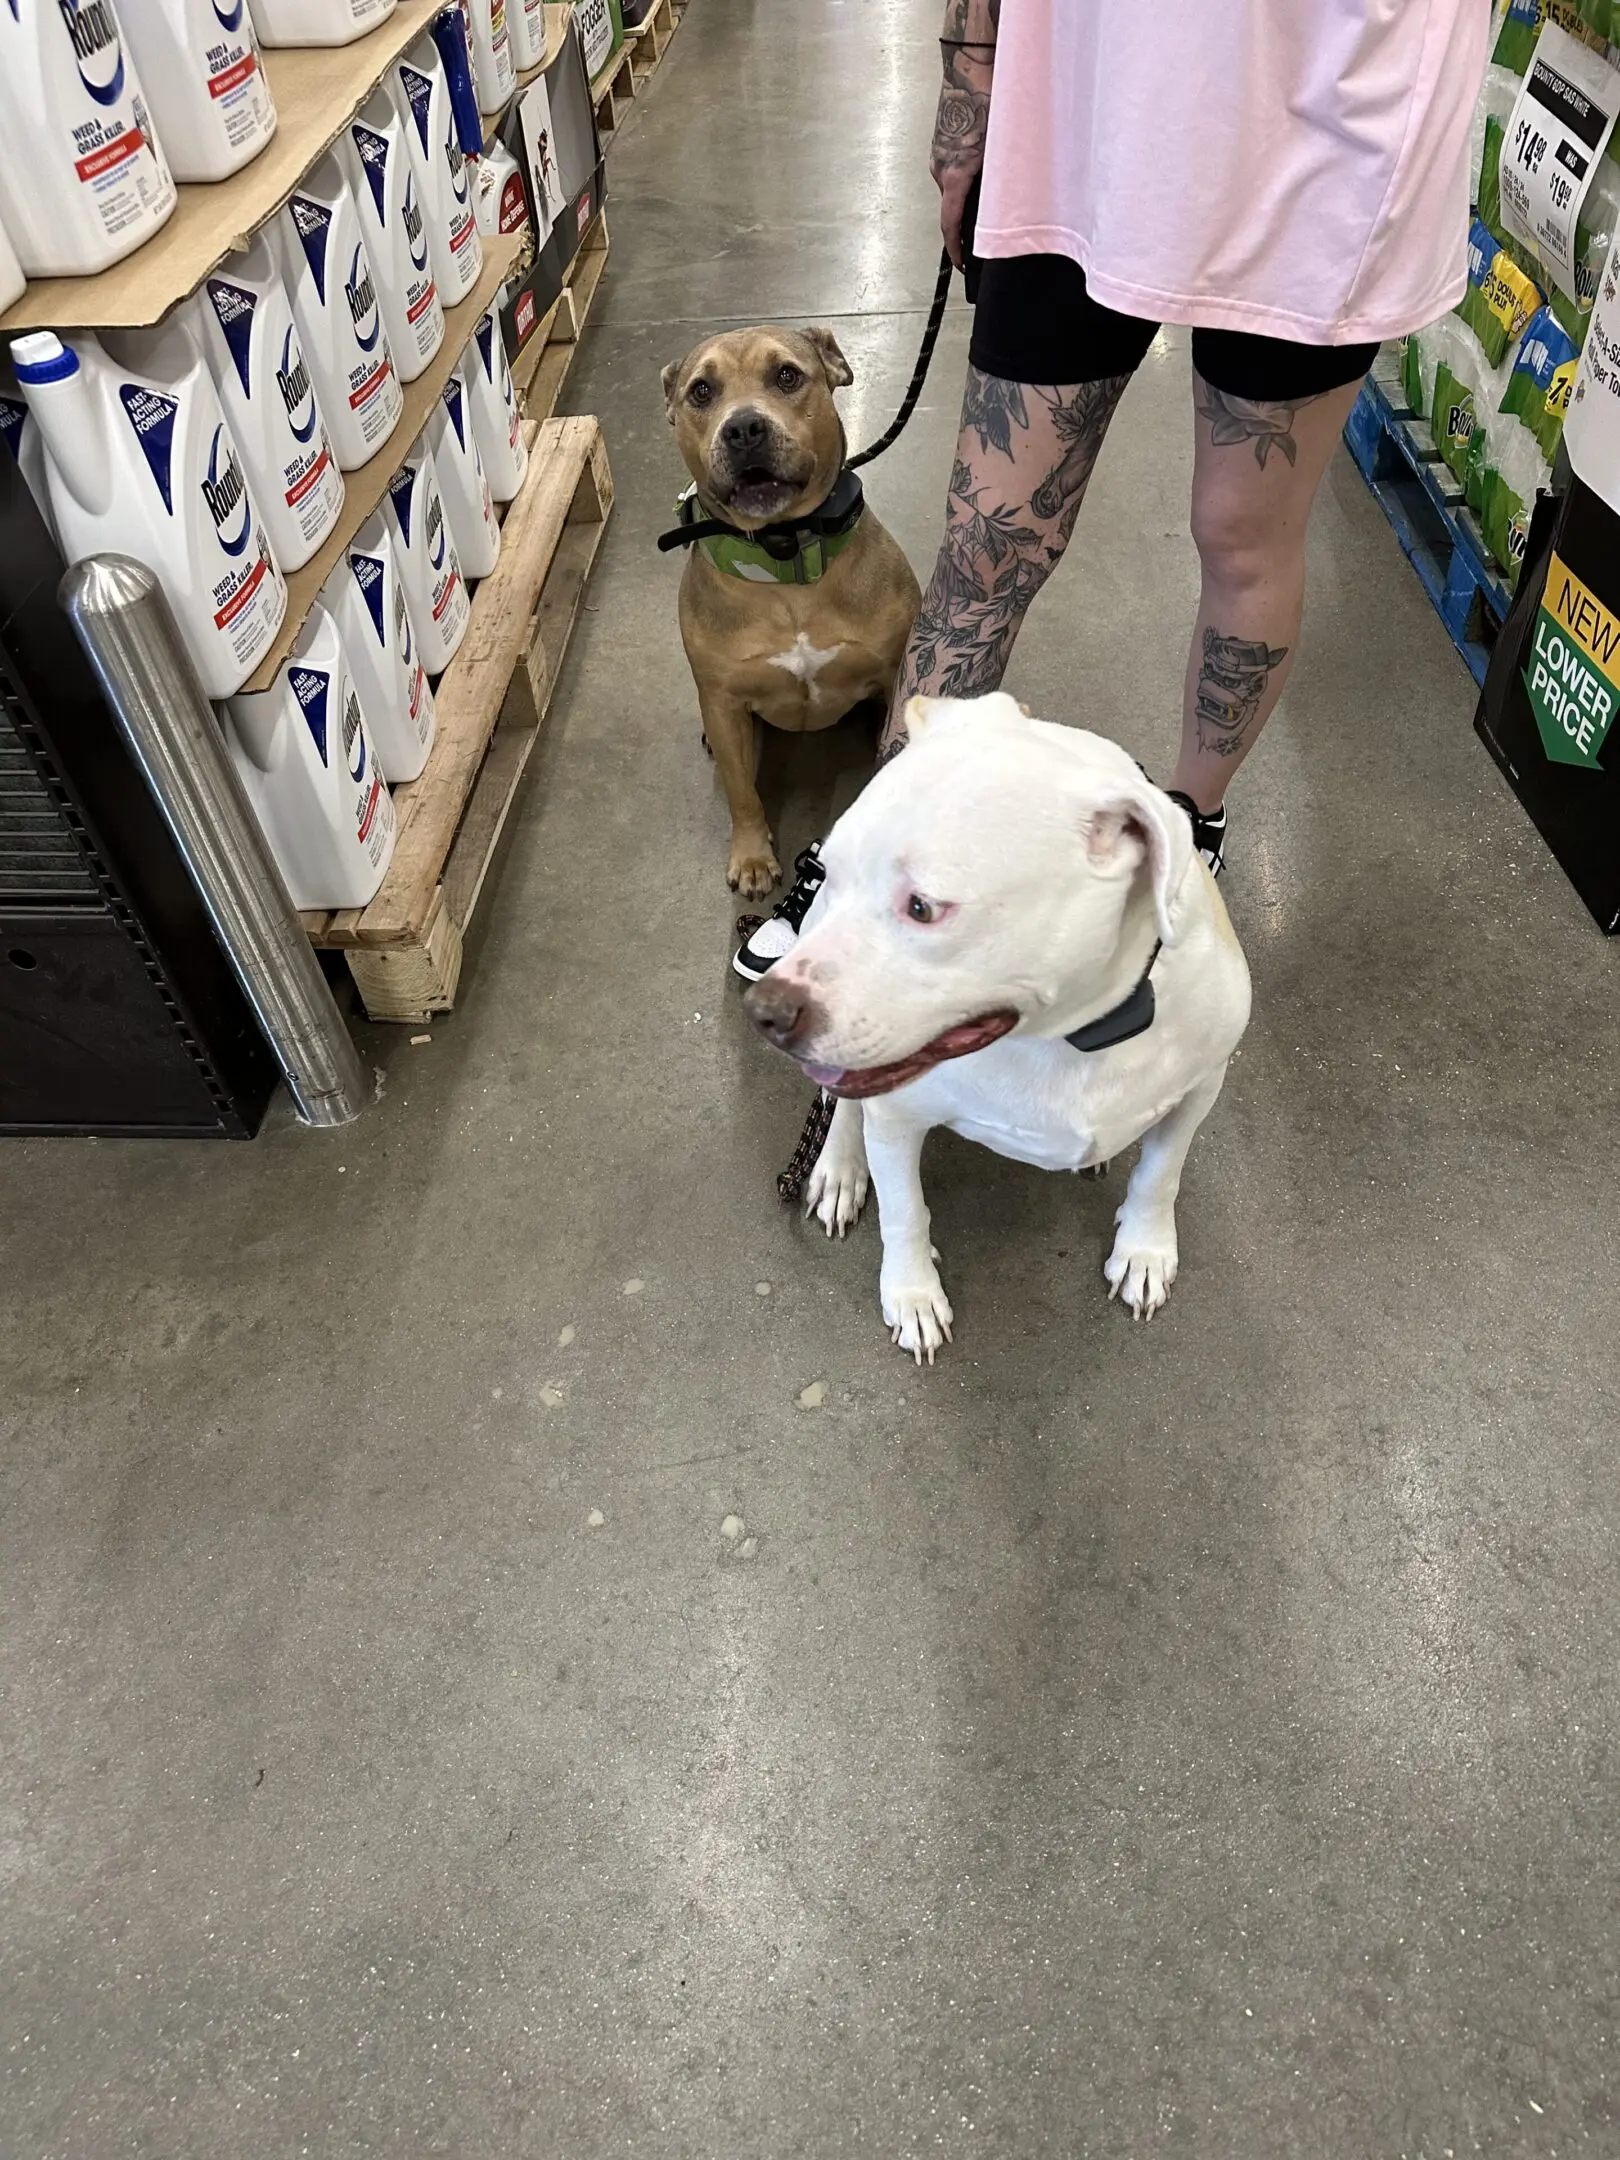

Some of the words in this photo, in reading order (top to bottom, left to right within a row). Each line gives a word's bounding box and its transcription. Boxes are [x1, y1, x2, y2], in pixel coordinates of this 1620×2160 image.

[1534, 63, 1555, 88] BOUNTY
[72, 121, 95, 141] WEED
[77, 132, 105, 155] GRASS
[1564, 149, 1578, 169] WAS
[126, 391, 147, 411] FAST-
[132, 396, 161, 423] ACTING
[136, 403, 174, 435] FORMULA
[284, 460, 299, 477] WEED
[287, 465, 305, 486] GRASS
[212, 576, 231, 597] WEED
[216, 581, 238, 607] GRASS
[237, 561, 253, 584] KILLER
[1557, 578, 1620, 664] NEW
[293, 672, 308, 689] FAST-
[297, 675, 317, 698] ACTING
[1535, 621, 1612, 729] LOWER
[300, 680, 326, 707] FORMULA
[1531, 661, 1596, 756] PRICE
